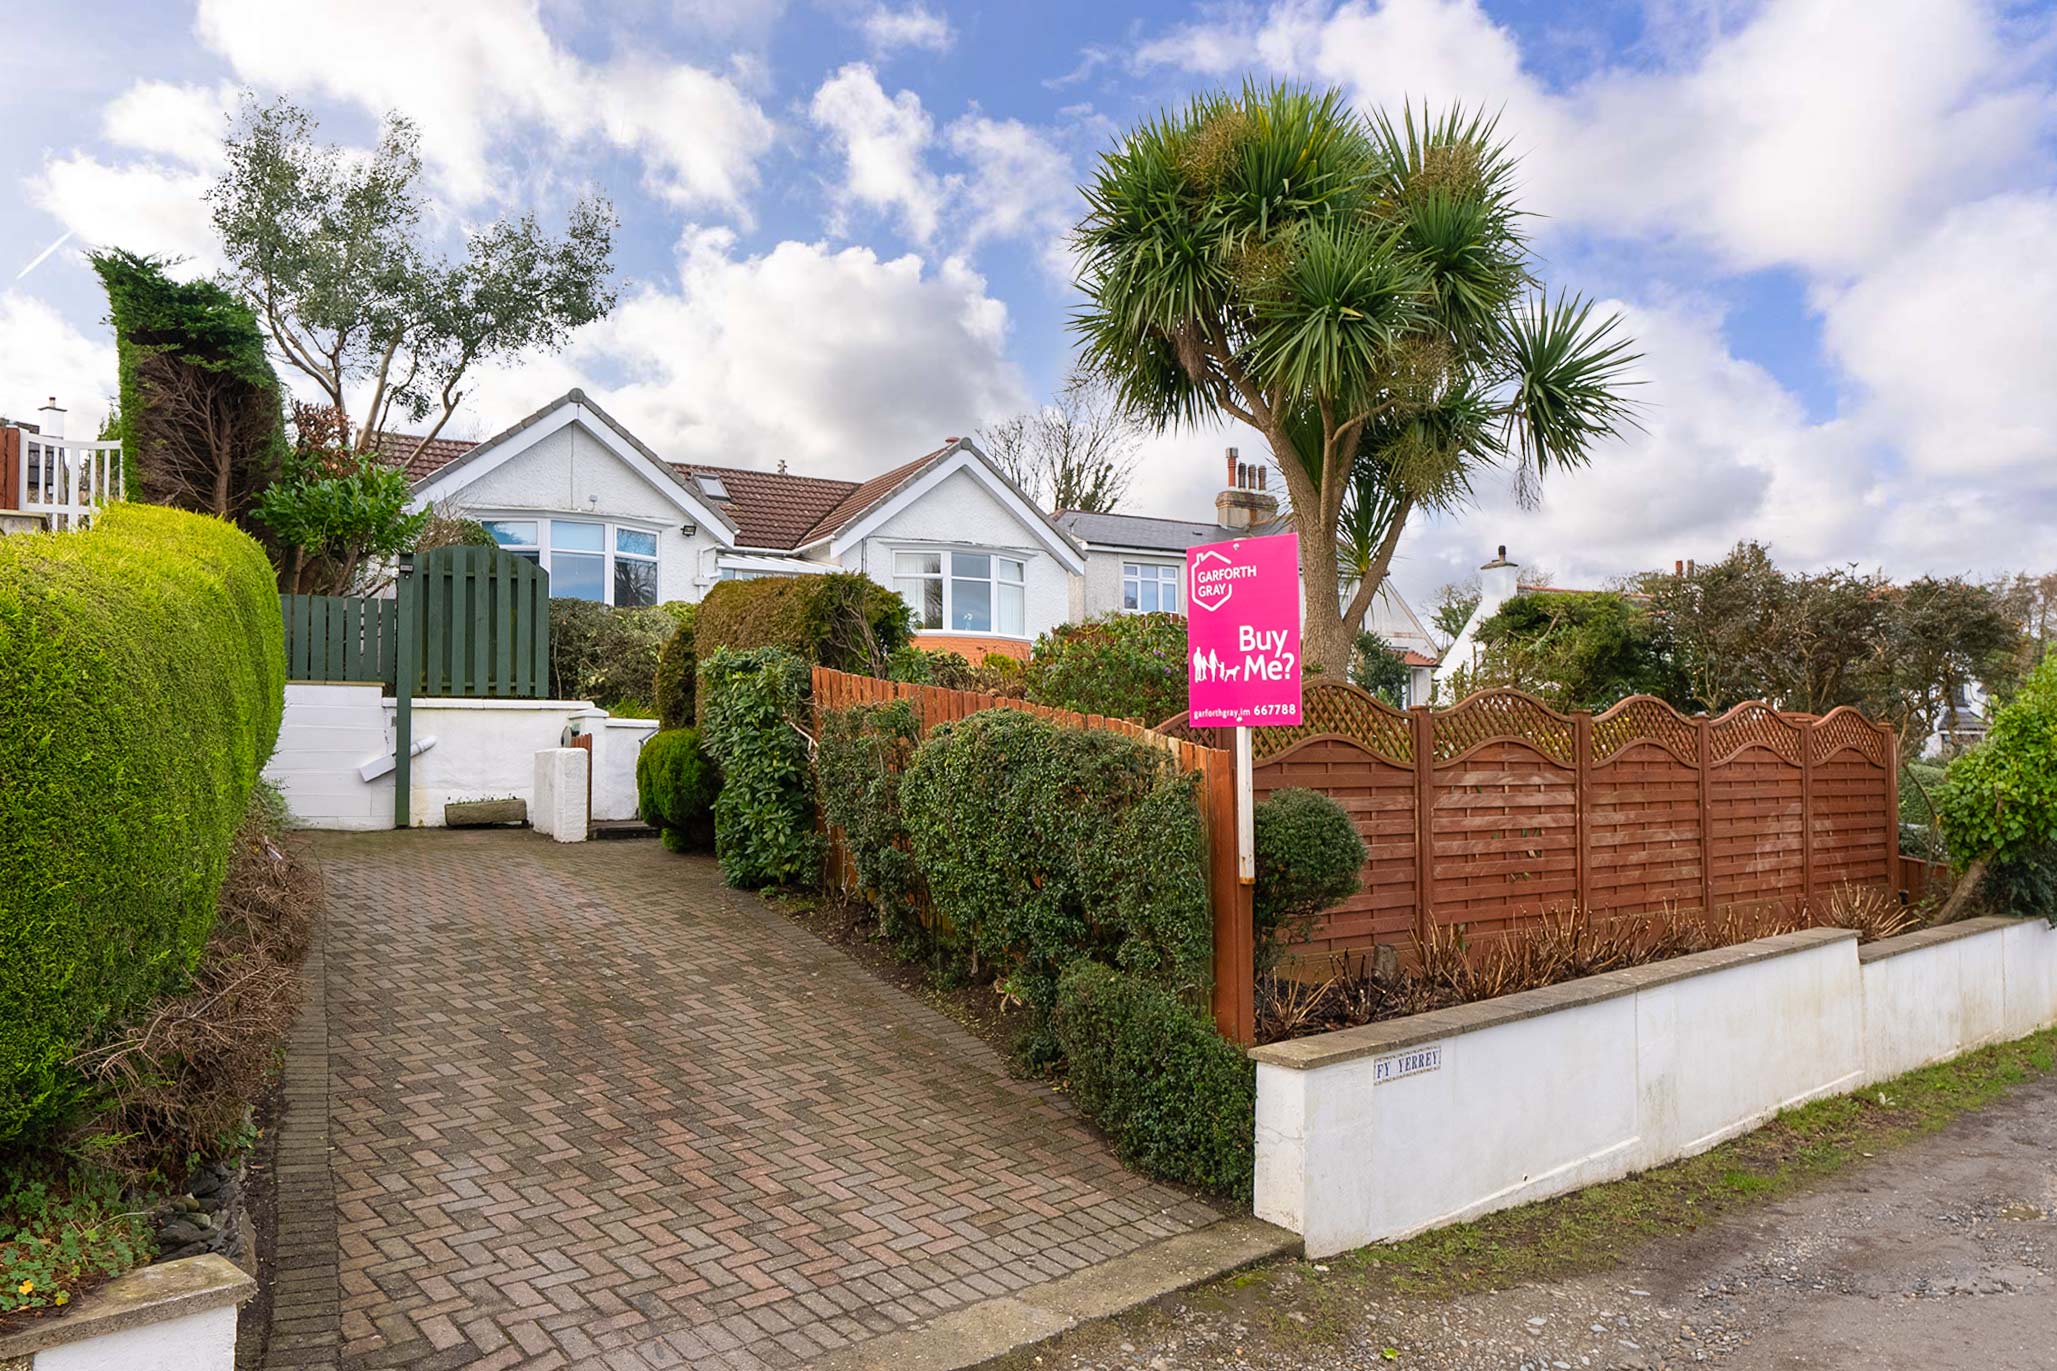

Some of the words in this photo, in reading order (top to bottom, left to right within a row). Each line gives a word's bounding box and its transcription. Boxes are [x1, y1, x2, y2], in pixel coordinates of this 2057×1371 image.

[1198, 565, 1257, 583] GARFORTH
[1198, 583, 1226, 597] GRAY
[1239, 625, 1288, 658] Buy
[1244, 652, 1295, 681] Me?
[1253, 704, 1296, 716] 667788
[1377, 1061, 1390, 1079] FY
[1398, 1050, 1439, 1073] YERREY
